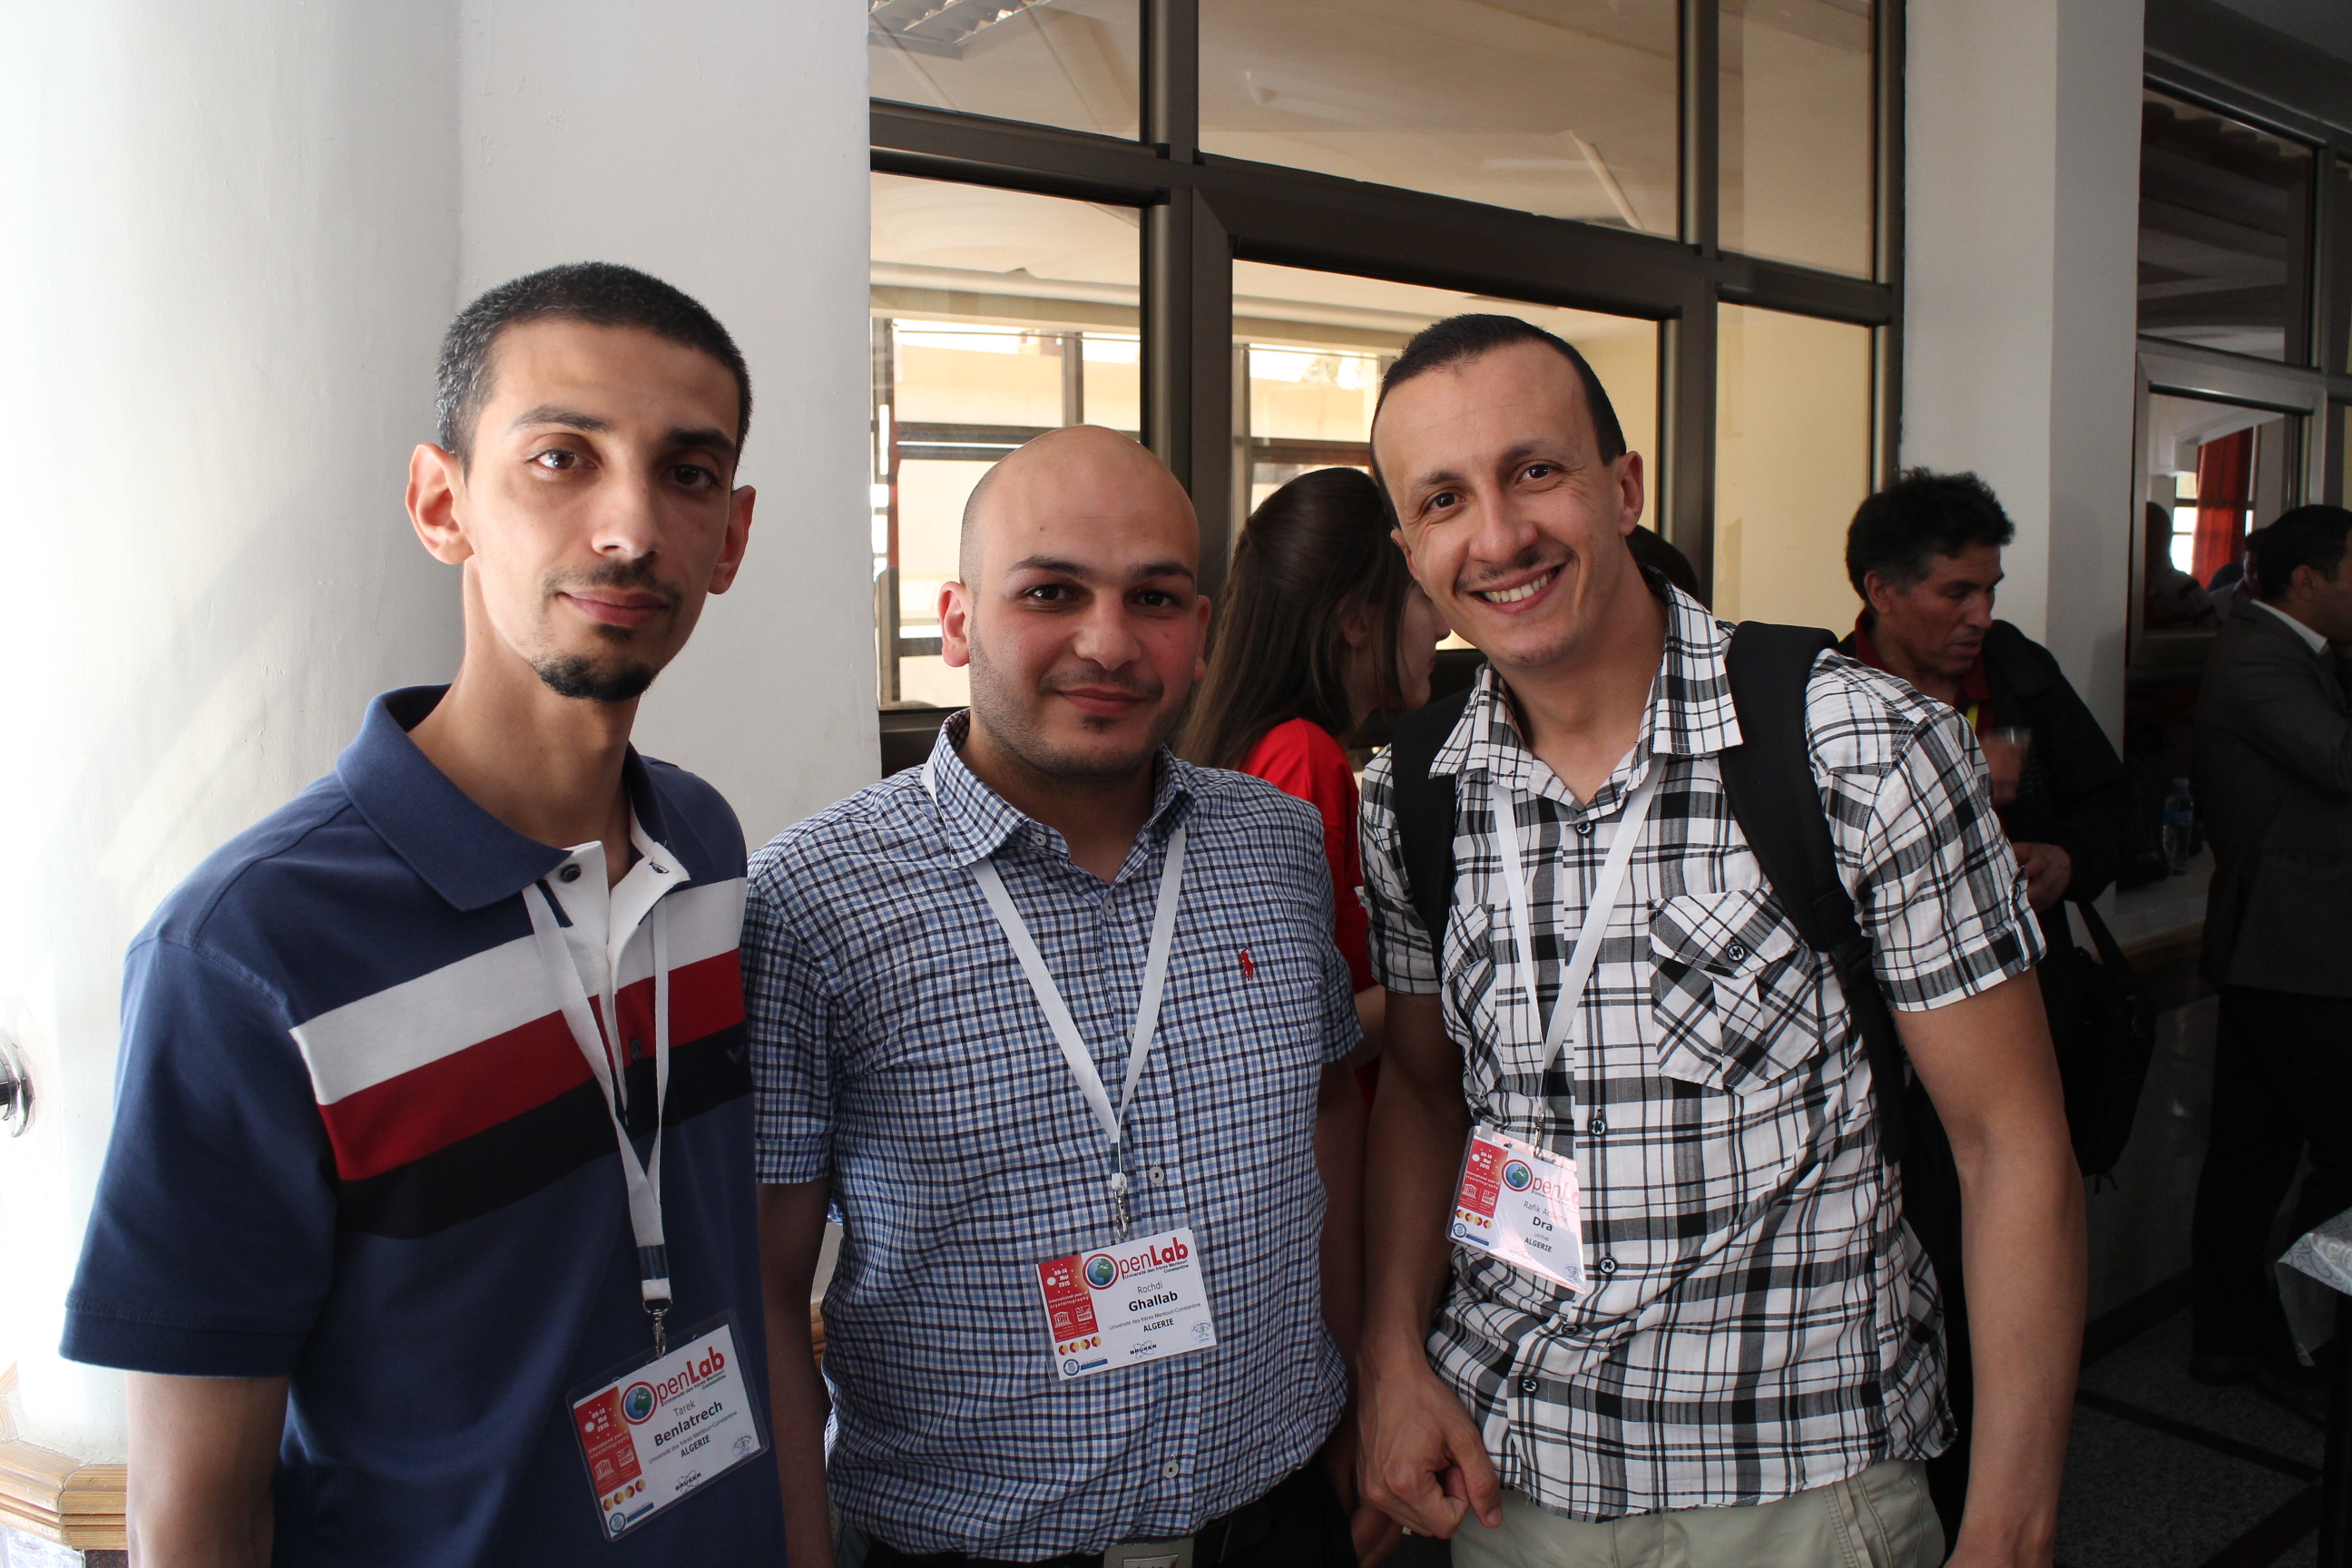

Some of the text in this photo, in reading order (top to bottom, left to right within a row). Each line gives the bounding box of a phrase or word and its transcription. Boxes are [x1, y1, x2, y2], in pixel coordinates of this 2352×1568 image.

[1524, 1200, 1541, 1213] Rafik
[1532, 1216, 1553, 1231] Dra
[1524, 1237, 1553, 1252] ALGERIE
[1124, 1270, 1146, 1279] Université
[1168, 1259, 1188, 1268] Mentouri
[1163, 1264, 1189, 1274] Constantine
[1137, 1280, 1163, 1295] Rochdi
[1050, 1296, 1090, 1309] crystallography
[1128, 1290, 1179, 1312] Ghallab
[1108, 1320, 1132, 1330] Université
[1143, 1318, 1175, 1333] ALGERIE
[1130, 1344, 1157, 1355] BRUKER
[701, 1375, 726, 1390] Constantine
[663, 1391, 685, 1406] Université
[673, 1400, 696, 1417] Tarek
[654, 1401, 723, 1447] Benlatrech
[681, 1434, 711, 1458] ALGERIE
[648, 1448, 671, 1465] Université
[671, 1444, 680, 1452] des
[675, 1472, 701, 1492] BRUKER
